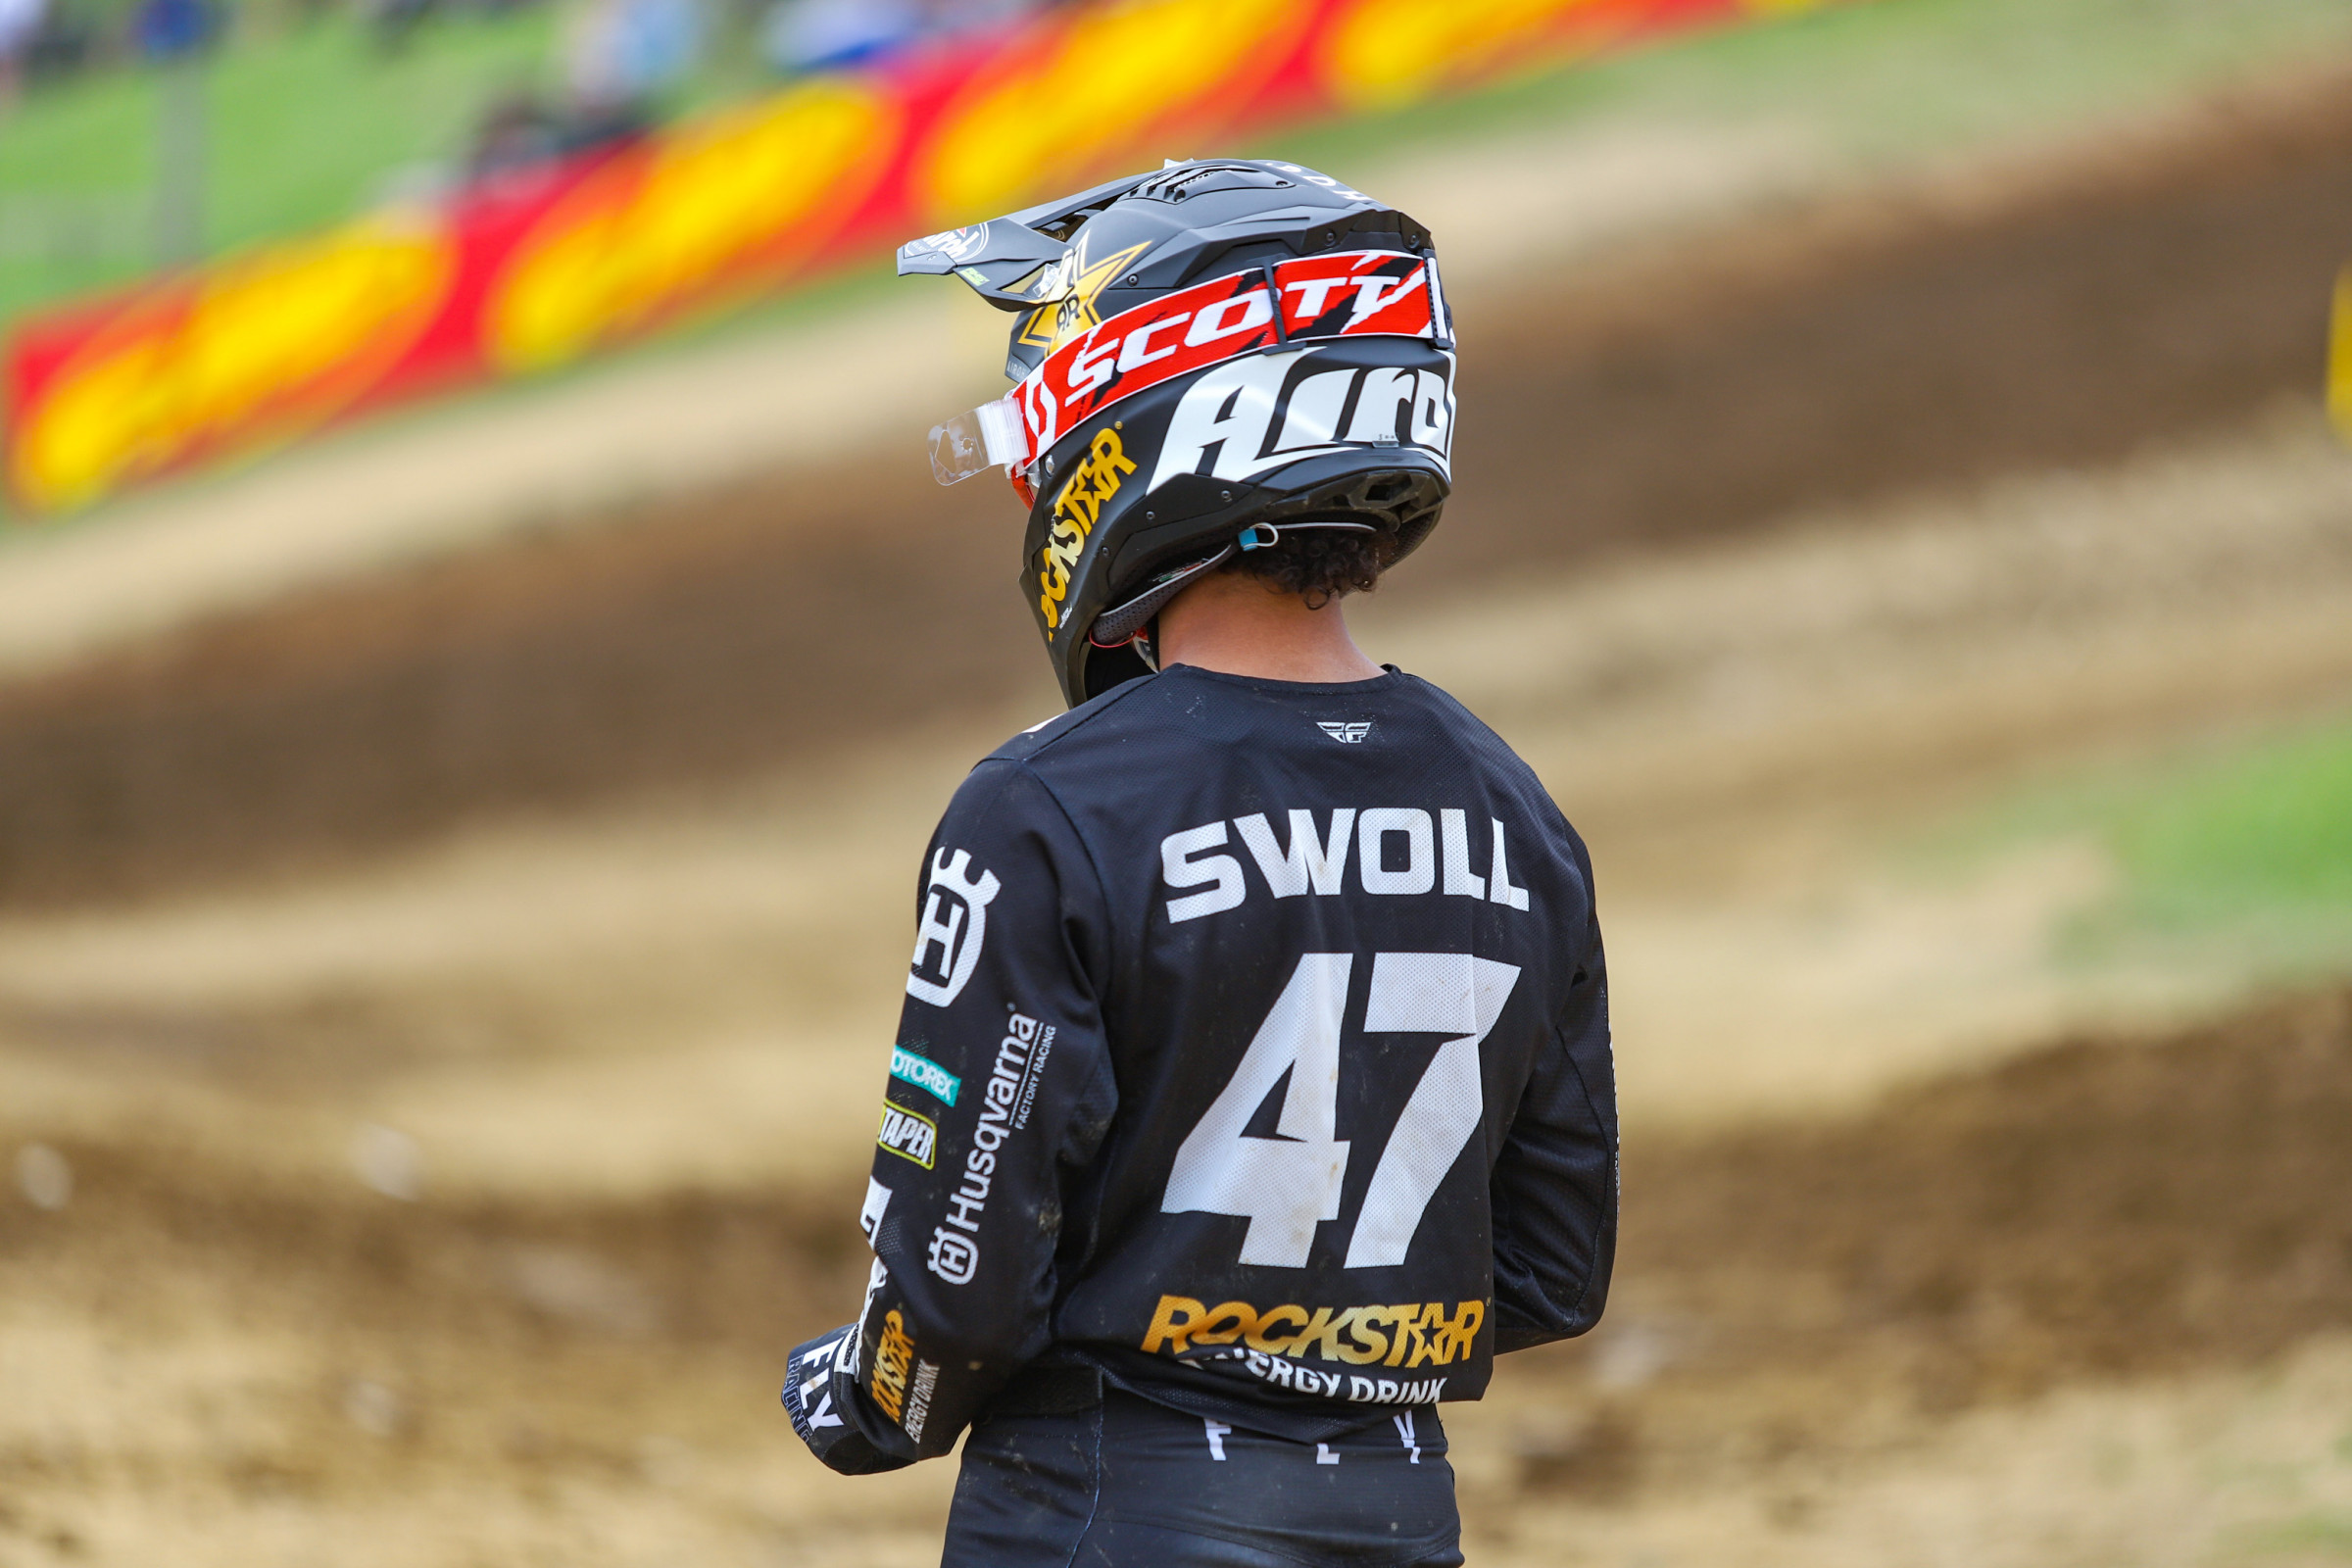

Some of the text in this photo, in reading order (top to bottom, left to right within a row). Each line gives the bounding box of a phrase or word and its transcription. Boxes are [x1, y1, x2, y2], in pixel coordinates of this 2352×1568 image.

[1065, 274, 1401, 409] SCOTT
[1041, 427, 1137, 642] OCKSTAR
[1160, 808, 1530, 923] SWOLL
[946, 1012, 1038, 1233] Husqvarna
[1014, 1024, 1056, 1130] FACTORY RACING
[1160, 952, 1522, 1269] 47
[802, 1336, 845, 1433] FLY
[871, 1309, 915, 1423] OCKSTAR
[1140, 1294, 1485, 1368] ROCKSTAR
[1179, 1347, 1448, 1404] ERGY DRINK
[782, 1354, 813, 1444] RACING
[905, 1358, 941, 1445] ENERGY DRINK
